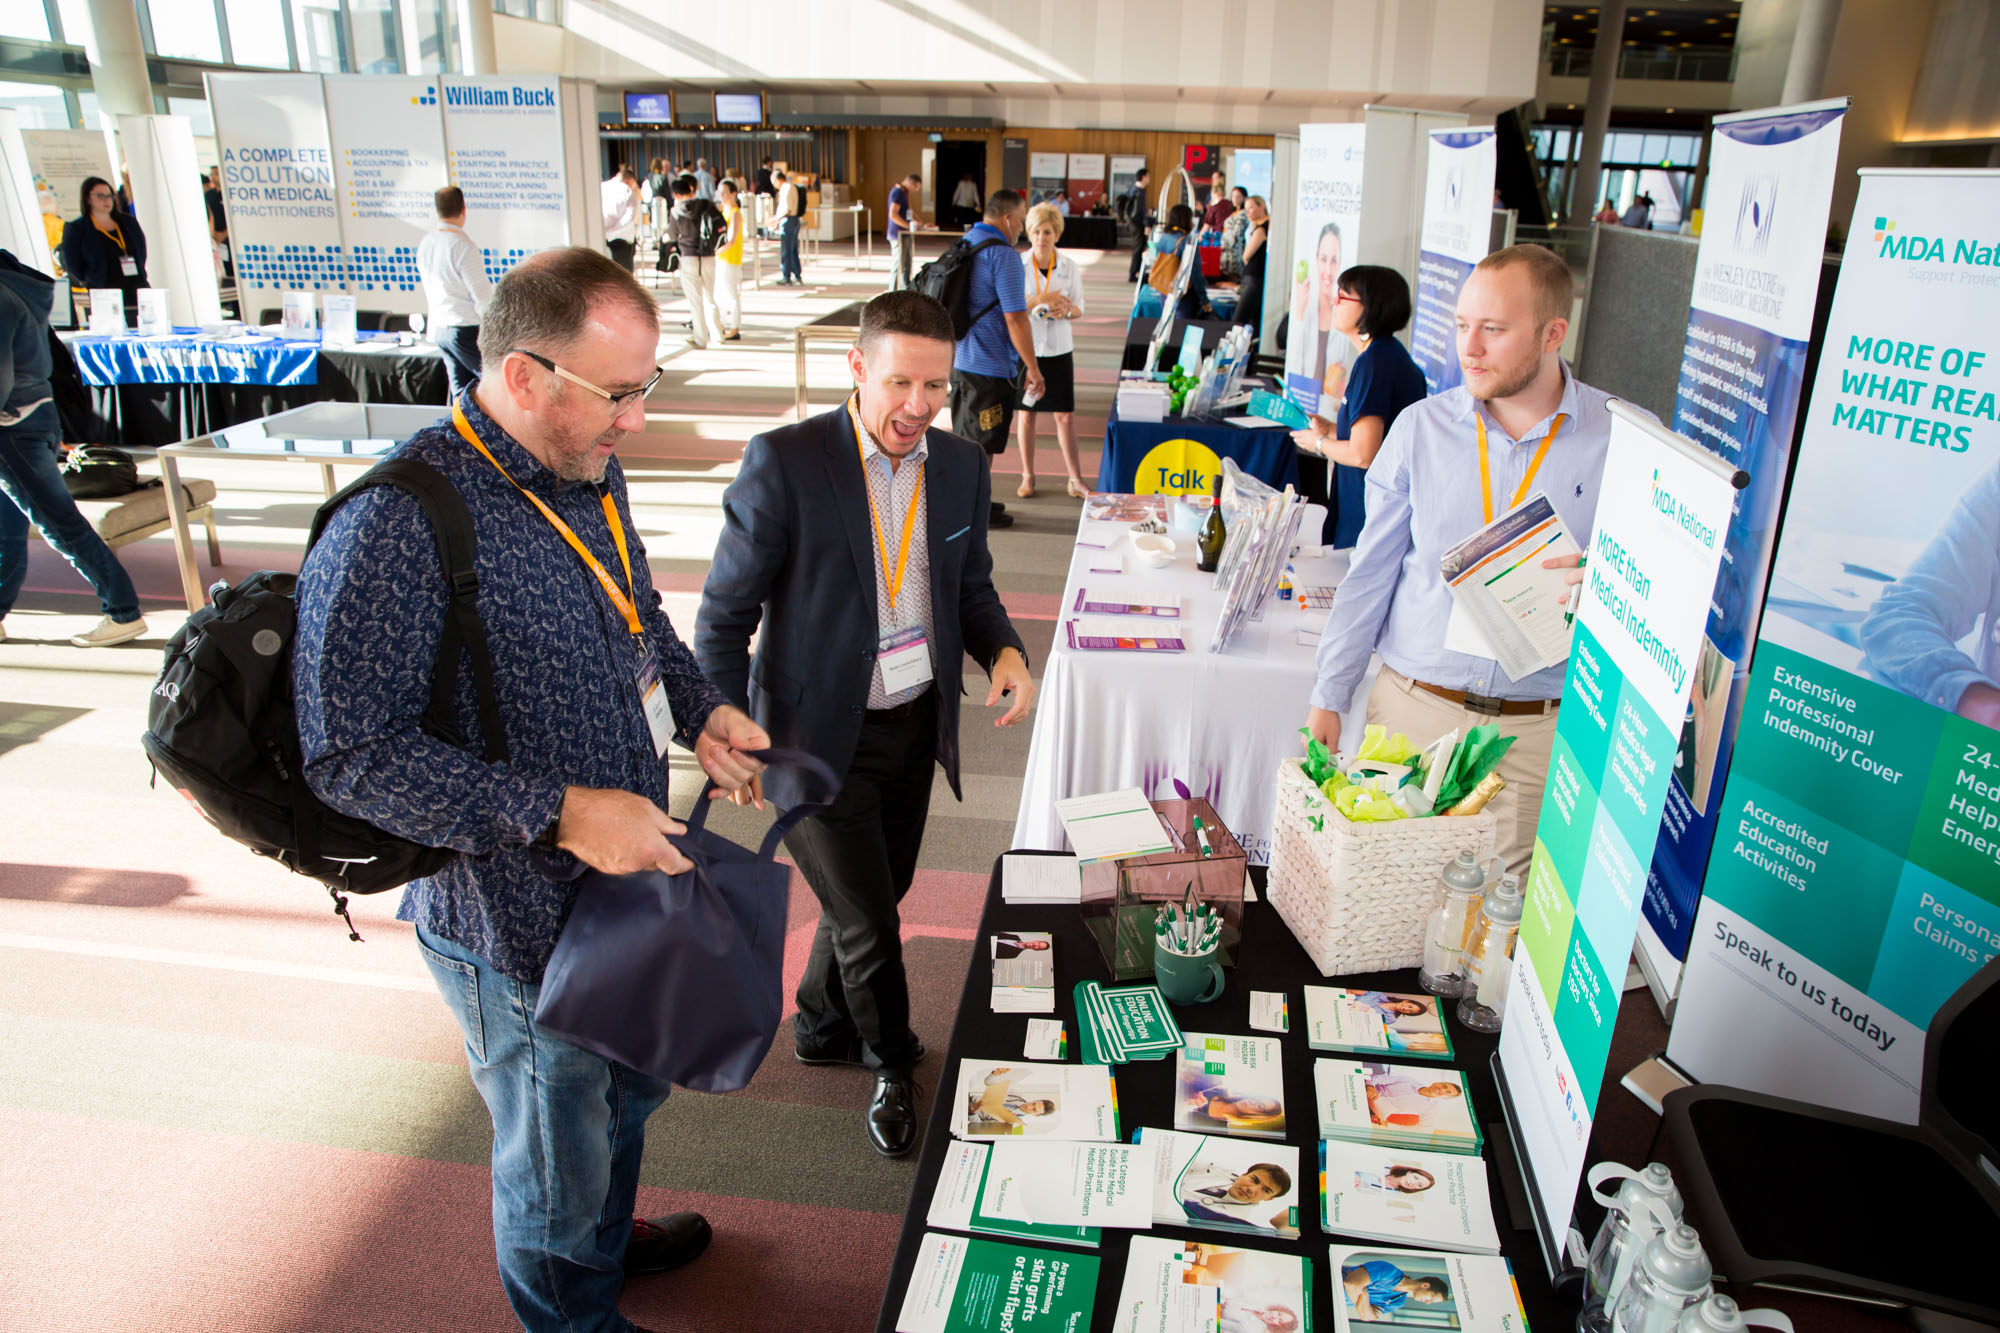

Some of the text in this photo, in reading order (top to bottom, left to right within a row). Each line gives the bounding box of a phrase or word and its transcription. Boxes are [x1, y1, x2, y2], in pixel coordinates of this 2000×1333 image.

[446, 86, 555, 106] William Buck
[224, 149, 328, 162] A COMPLETE
[351, 149, 409, 157] BOOKKEEPING
[353, 159, 406, 167] ACCOUNTING
[226, 166, 331, 184] SOLUTION
[354, 169, 382, 177] ADVICE
[354, 180, 395, 188] GST BAS
[458, 171, 493, 179] SELLING
[495, 171, 517, 179] YOUR
[459, 181, 548, 190] STRATEGIC PLANNING
[229, 187, 333, 201] FOR MEDICAL
[503, 203, 561, 211] STRUCTURING
[231, 206, 335, 217] PRACTITIONERS
[358, 210, 429, 218] SUPERANNUATION
[1879, 235, 2000, 268] MDA Nat
[1713, 263, 1778, 295] WESLEY CENTRE
[1907, 266, 2000, 287] Support Protec
[1699, 282, 1783, 320] HYPERBARIC MEDICINE
[1736, 340, 1746, 356] the
[1745, 345, 1756, 364] only
[1847, 335, 1986, 378] MORE OF
[1697, 367, 1723, 391] hyperbaric
[1722, 381, 1743, 399] services
[1704, 351, 1765, 388] and licensed Day Hospital
[1701, 397, 1720, 415] services
[1841, 369, 2000, 423] WHAT REA
[1831, 402, 1973, 454] MATTERS
[1158, 468, 1205, 489] Talk
[1477, 526, 1503, 548] Clinical
[1501, 513, 1527, 532] Update
[1652, 487, 1676, 521] MDA
[1677, 503, 1716, 551] National
[1597, 528, 1626, 576] MORE
[1625, 555, 1651, 601] than
[1590, 567, 1628, 625] Medical
[1626, 604, 1687, 695] Indemnity
[1773, 665, 1857, 713] Extensive
[1768, 688, 1875, 747] Professional
[1763, 709, 1903, 785] Indemnity Cover
[1955, 769, 2000, 803] Med
[1742, 800, 1829, 856] Accredited
[1948, 793, 2000, 833] Help
[1738, 819, 1817, 874] Education
[1732, 840, 1808, 892] Activities
[1913, 916, 1978, 964] Claims
[1574, 938, 1601, 997] Doctors for
[1567, 973, 1581, 1004] 1925
[1571, 955, 1602, 1028] Doctors Since
[1714, 921, 1897, 1052] Speak to us today
[1115, 1003, 1136, 1041] your fingertips
[1124, 997, 1151, 1039] EDUCATION
[1135, 996, 1155, 1024] ONLINE
[1518, 963, 1532, 1001] Speak
[1539, 1021, 1553, 1060] today
[1085, 1148, 1097, 1172] Medical
[1096, 1148, 1108, 1193] Students and
[1116, 1149, 1129, 1196] Risk Category
[1106, 1148, 1119, 1207] Guide for Medical
[1448, 1182, 1456, 1206] Practice
[1456, 1162, 1466, 1198] Responding
[996, 1180, 1008, 1212] MDA National
[1081, 1173, 1095, 1217] Practitioners
[1460, 1205, 1471, 1235] Complaints
[1056, 1276, 1067, 1291] you
[1060, 1262, 1070, 1275] Are
[1162, 1262, 1171, 1286] Starting
[998, 1256, 1026, 1333] or skin flaps?
[1021, 1259, 1046, 1322] skin grafts
[1041, 1260, 1060, 1315] GP performing
[1161, 1293, 1169, 1314] Private
[1456, 1258, 1475, 1320] Dealing with Complaints
[1502, 1317, 1511, 1331] MDA
